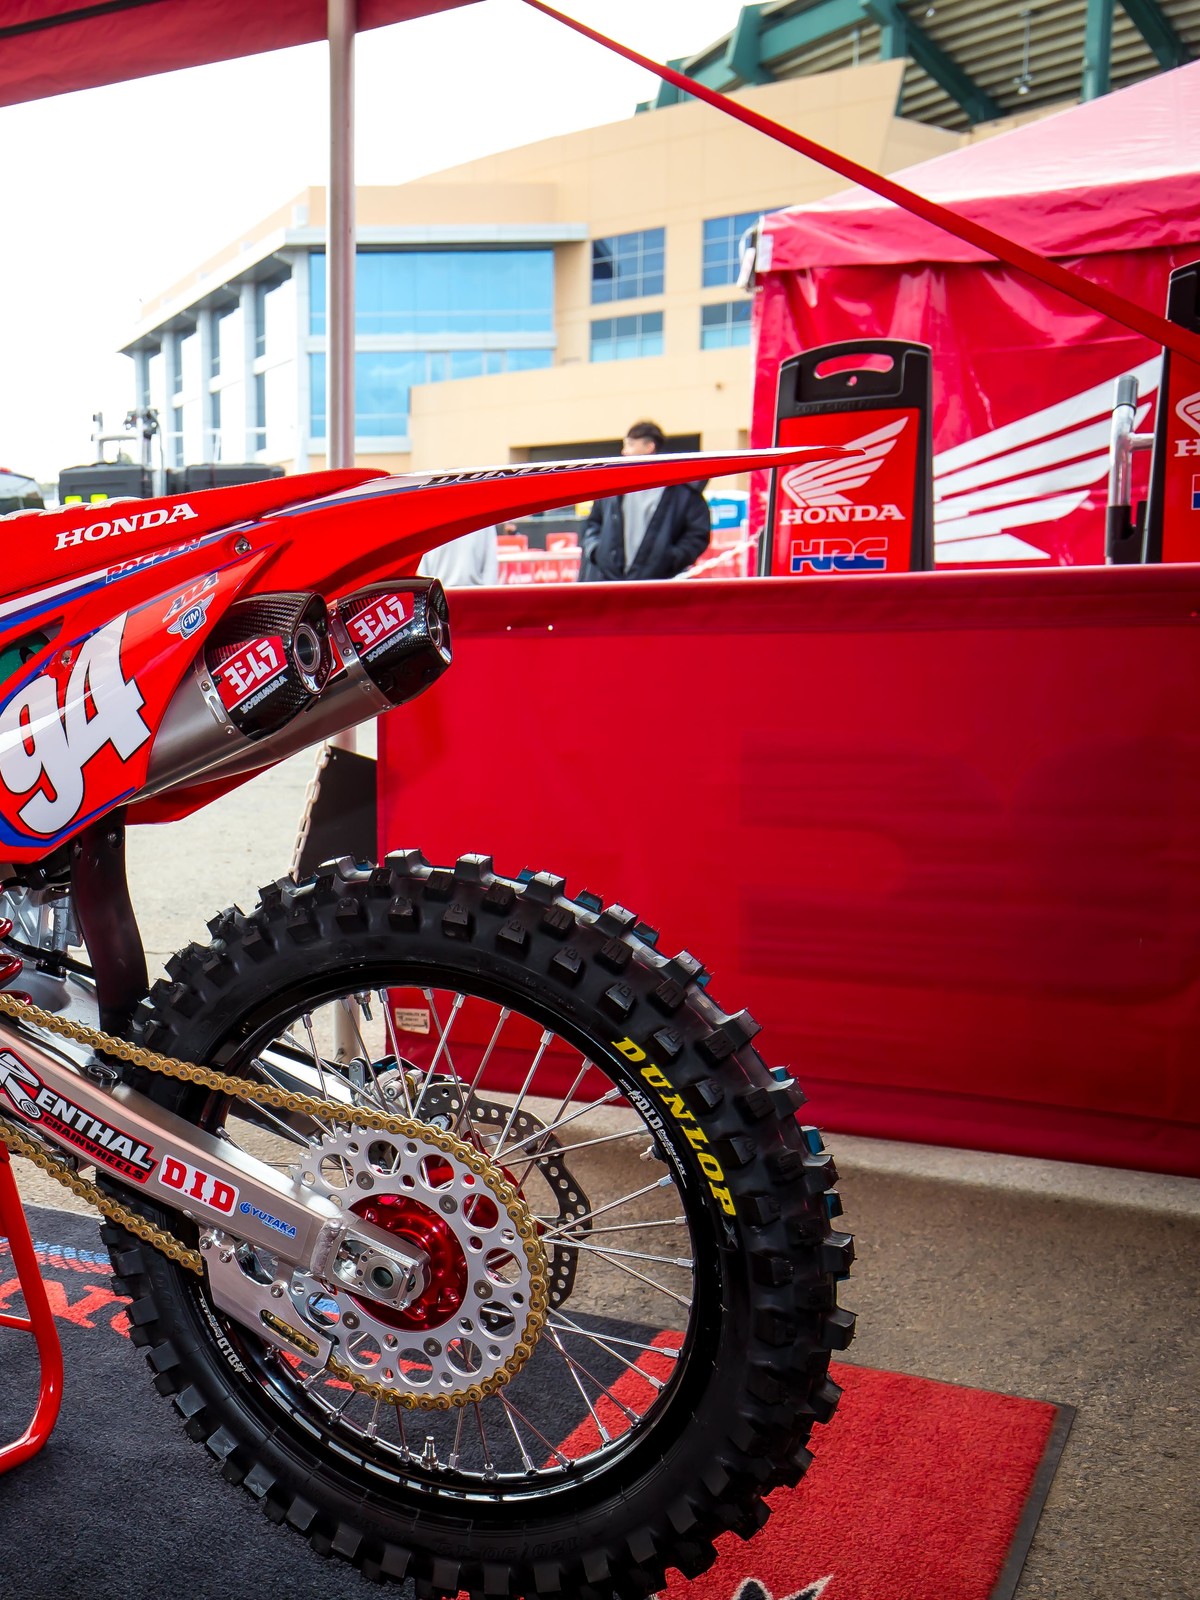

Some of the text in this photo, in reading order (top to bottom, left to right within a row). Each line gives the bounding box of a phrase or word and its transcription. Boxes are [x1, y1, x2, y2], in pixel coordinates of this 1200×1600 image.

[54, 503, 199, 551] HONDA
[779, 504, 906, 526] HONDA
[790, 537, 889, 573] HRC
[183, 610, 199, 628] FIM
[365, 628, 411, 663] YOSHIMURA
[239, 675, 289, 715] YOSHIMURA
[611, 1036, 737, 1216] DUNLOP
[43, 1115, 146, 1181] CHAINWHEELS
[162, 1157, 236, 1213] D.I.D
[252, 1207, 297, 1236] YUTAKA
